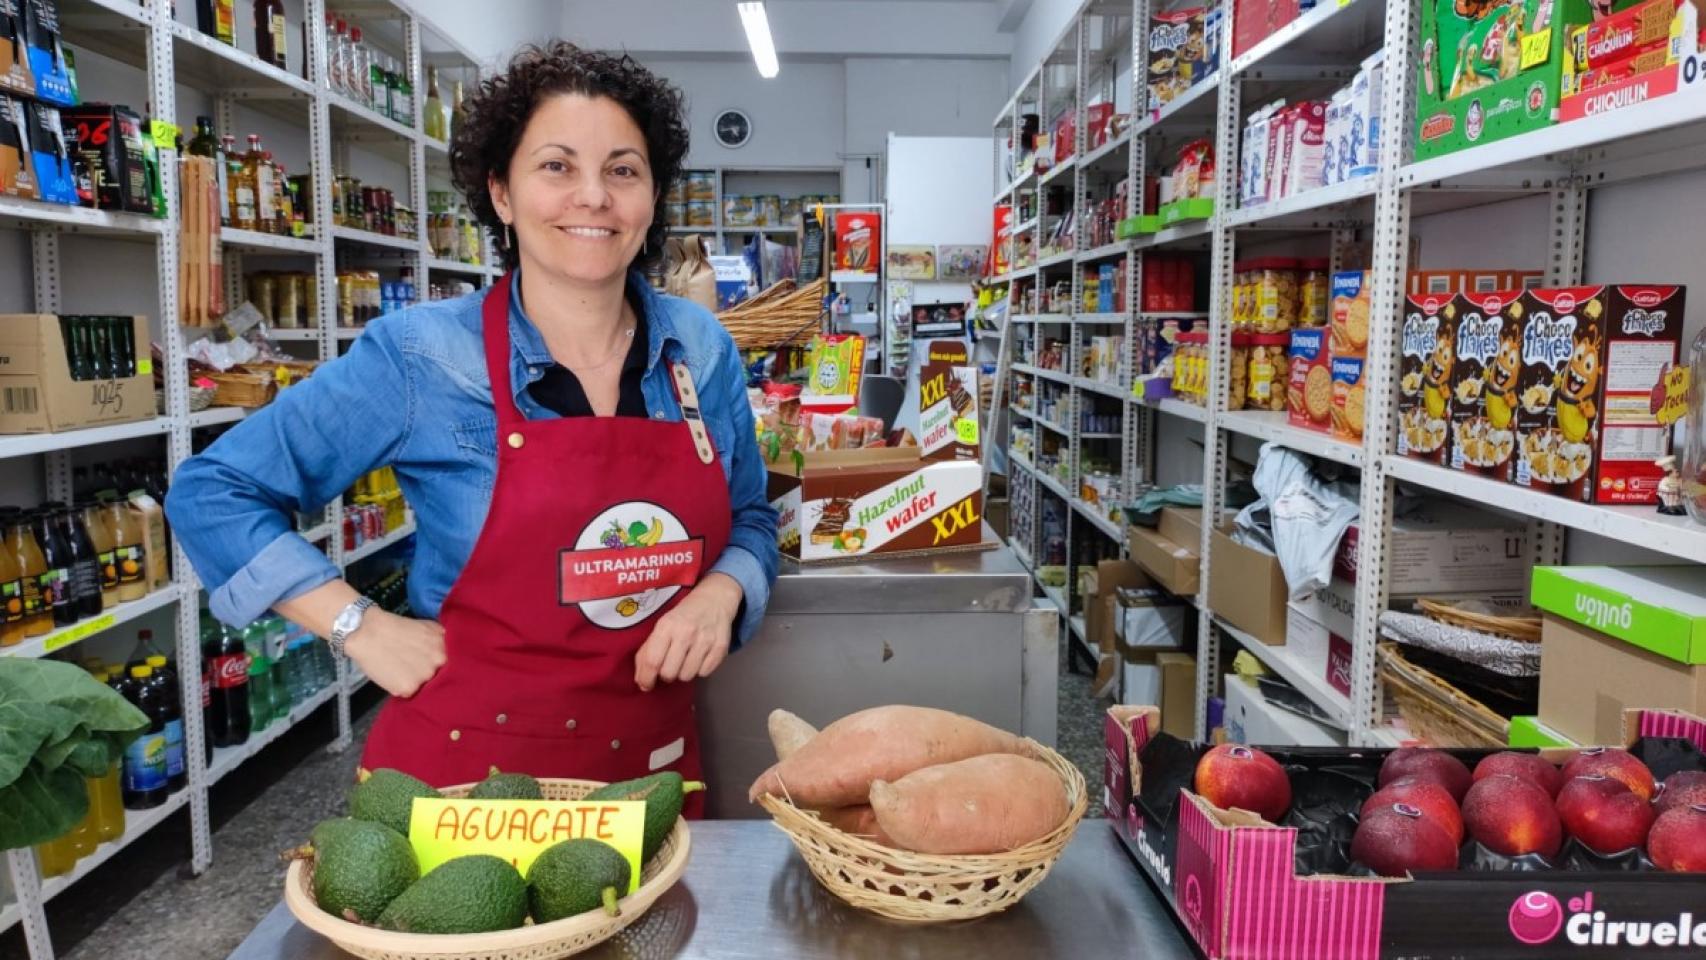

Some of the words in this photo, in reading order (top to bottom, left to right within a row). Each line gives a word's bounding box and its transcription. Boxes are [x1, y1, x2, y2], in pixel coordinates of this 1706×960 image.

[1588, 31, 1633, 58] CHIQUILIN
[1584, 82, 1649, 116] CHIQUILIN
[1467, 316, 1498, 336] Choco
[1535, 316, 1572, 338] Choco
[1625, 315, 1663, 333] flakes
[1459, 324, 1498, 361] flakes
[1525, 325, 1572, 365] flakes
[92, 381, 124, 414] 1925
[921, 373, 947, 411] XXL
[923, 424, 948, 449] wafer
[858, 474, 926, 526] Hazelnut
[886, 490, 937, 534] wafer
[931, 497, 980, 546] XXL
[573, 551, 693, 576] ULTRAMARINOS
[617, 569, 660, 585] PATRI
[1575, 592, 1633, 629] gullón
[435, 806, 620, 843] AGUACATE
[1567, 891, 1593, 912] el
